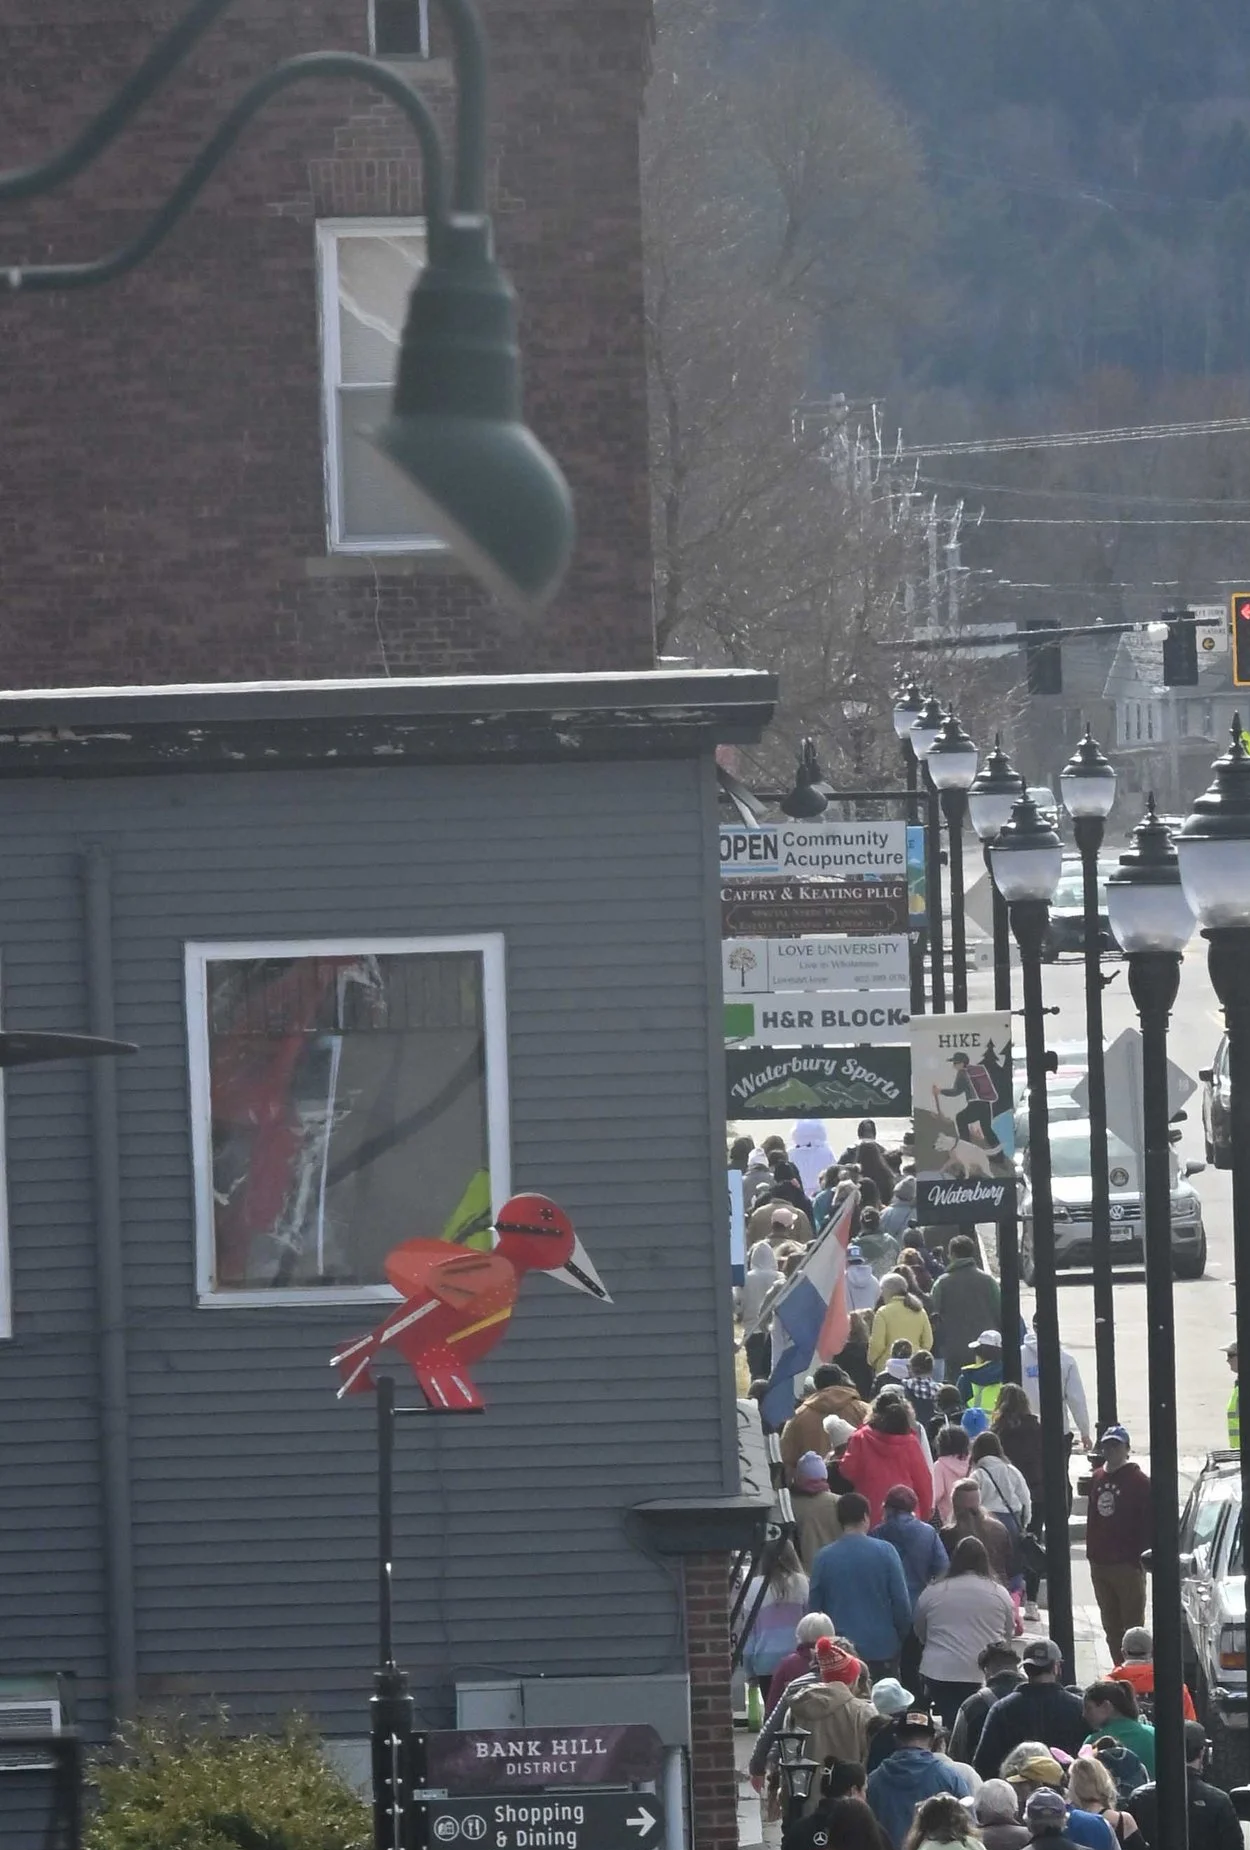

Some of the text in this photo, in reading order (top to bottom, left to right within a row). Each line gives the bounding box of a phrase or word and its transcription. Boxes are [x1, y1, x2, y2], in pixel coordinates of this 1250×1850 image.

[720, 834, 778, 861] OPEN
[782, 831, 889, 847] Community
[784, 852, 904, 869] Acupuncture
[780, 888, 793, 900] &
[799, 887, 863, 900] KEATING
[867, 887, 903, 898] PLLC
[778, 943, 899, 956] LOVE UNIVERSITY
[762, 1009, 903, 1029] H&R BLOCK
[938, 1033, 981, 1048] HIKE
[731, 1056, 901, 1100] Waterbury Sports
[928, 1181, 1005, 1206] Waterbury
[476, 1739, 607, 1758] BANK HILL
[506, 1761, 577, 1775] DISTRICT
[494, 1804, 585, 1825] Shopping
[495, 1828, 577, 1849] & Dining
